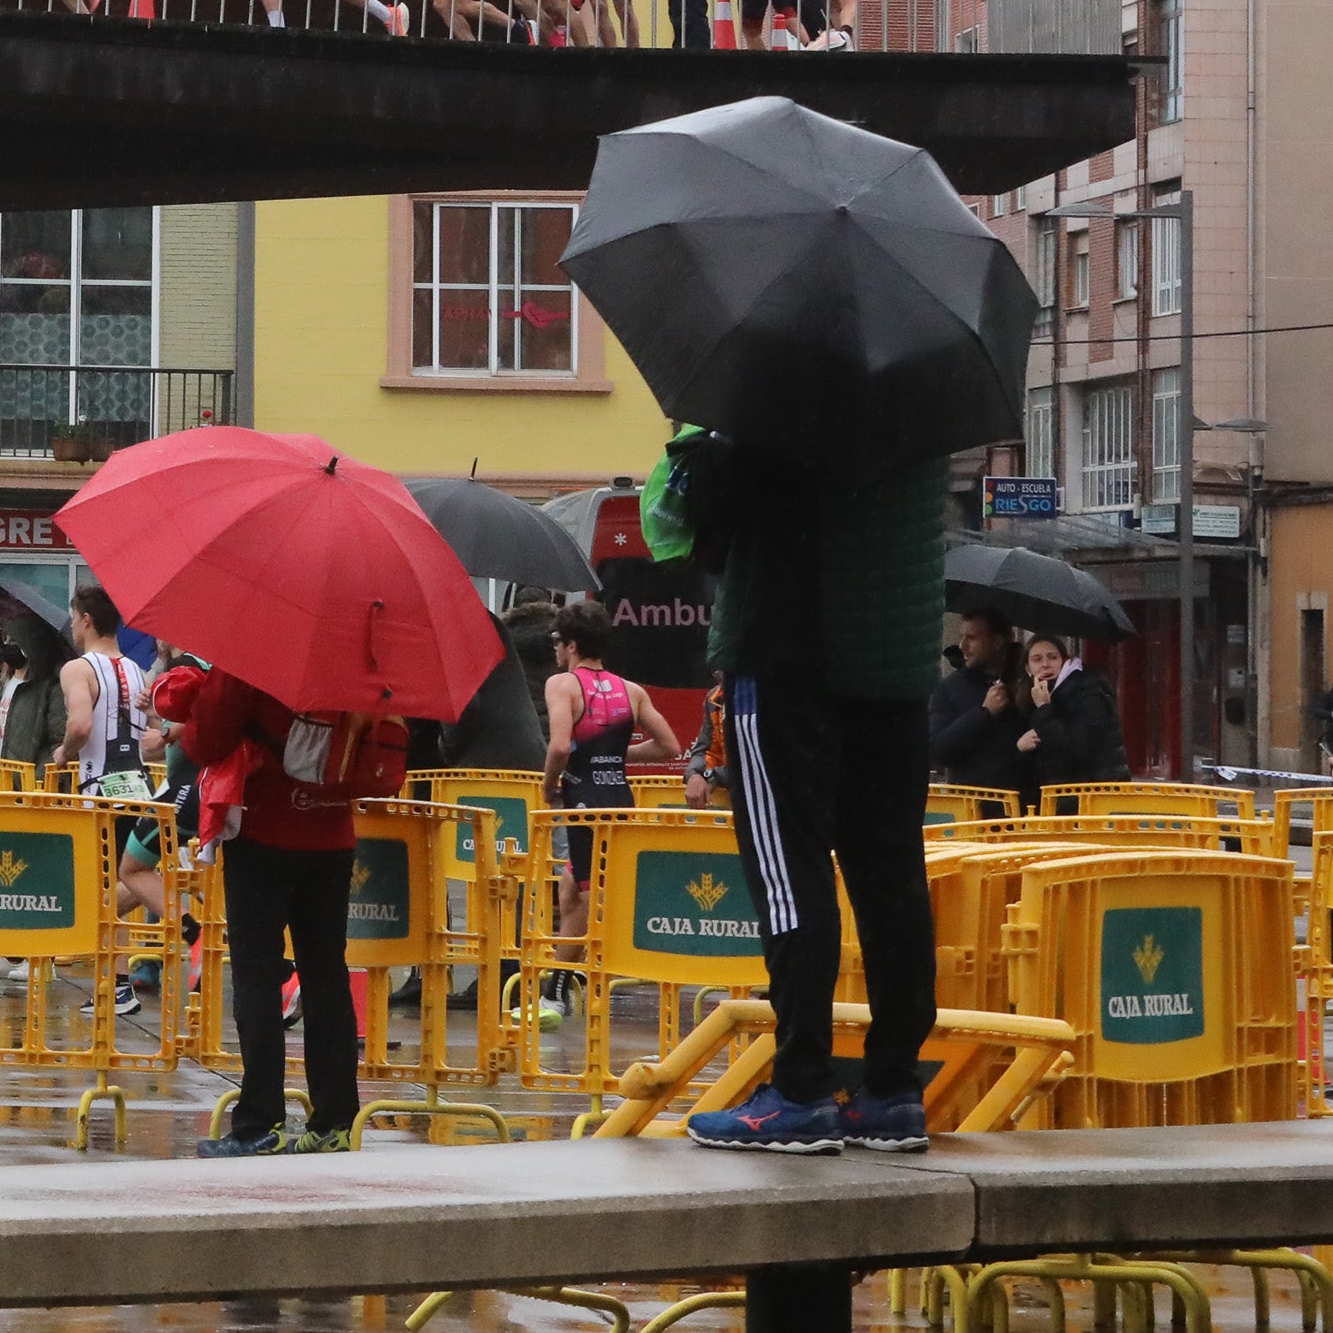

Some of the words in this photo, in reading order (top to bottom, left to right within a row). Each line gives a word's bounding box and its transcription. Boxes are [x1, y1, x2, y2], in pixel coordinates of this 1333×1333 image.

[996, 483, 1016, 493] AUTO
[1021, 484, 1052, 494] ESCUELA
[995, 495, 1052, 514] RIESGO
[612, 597, 715, 627] Ambu
[103, 783, 134, 798] 3631
[348, 902, 400, 922] RURAL
[646, 916, 695, 936] CAJA
[698, 919, 761, 939] RURAL
[1108, 995, 1143, 1019] CAJA
[1143, 993, 1193, 1017] RURAL
